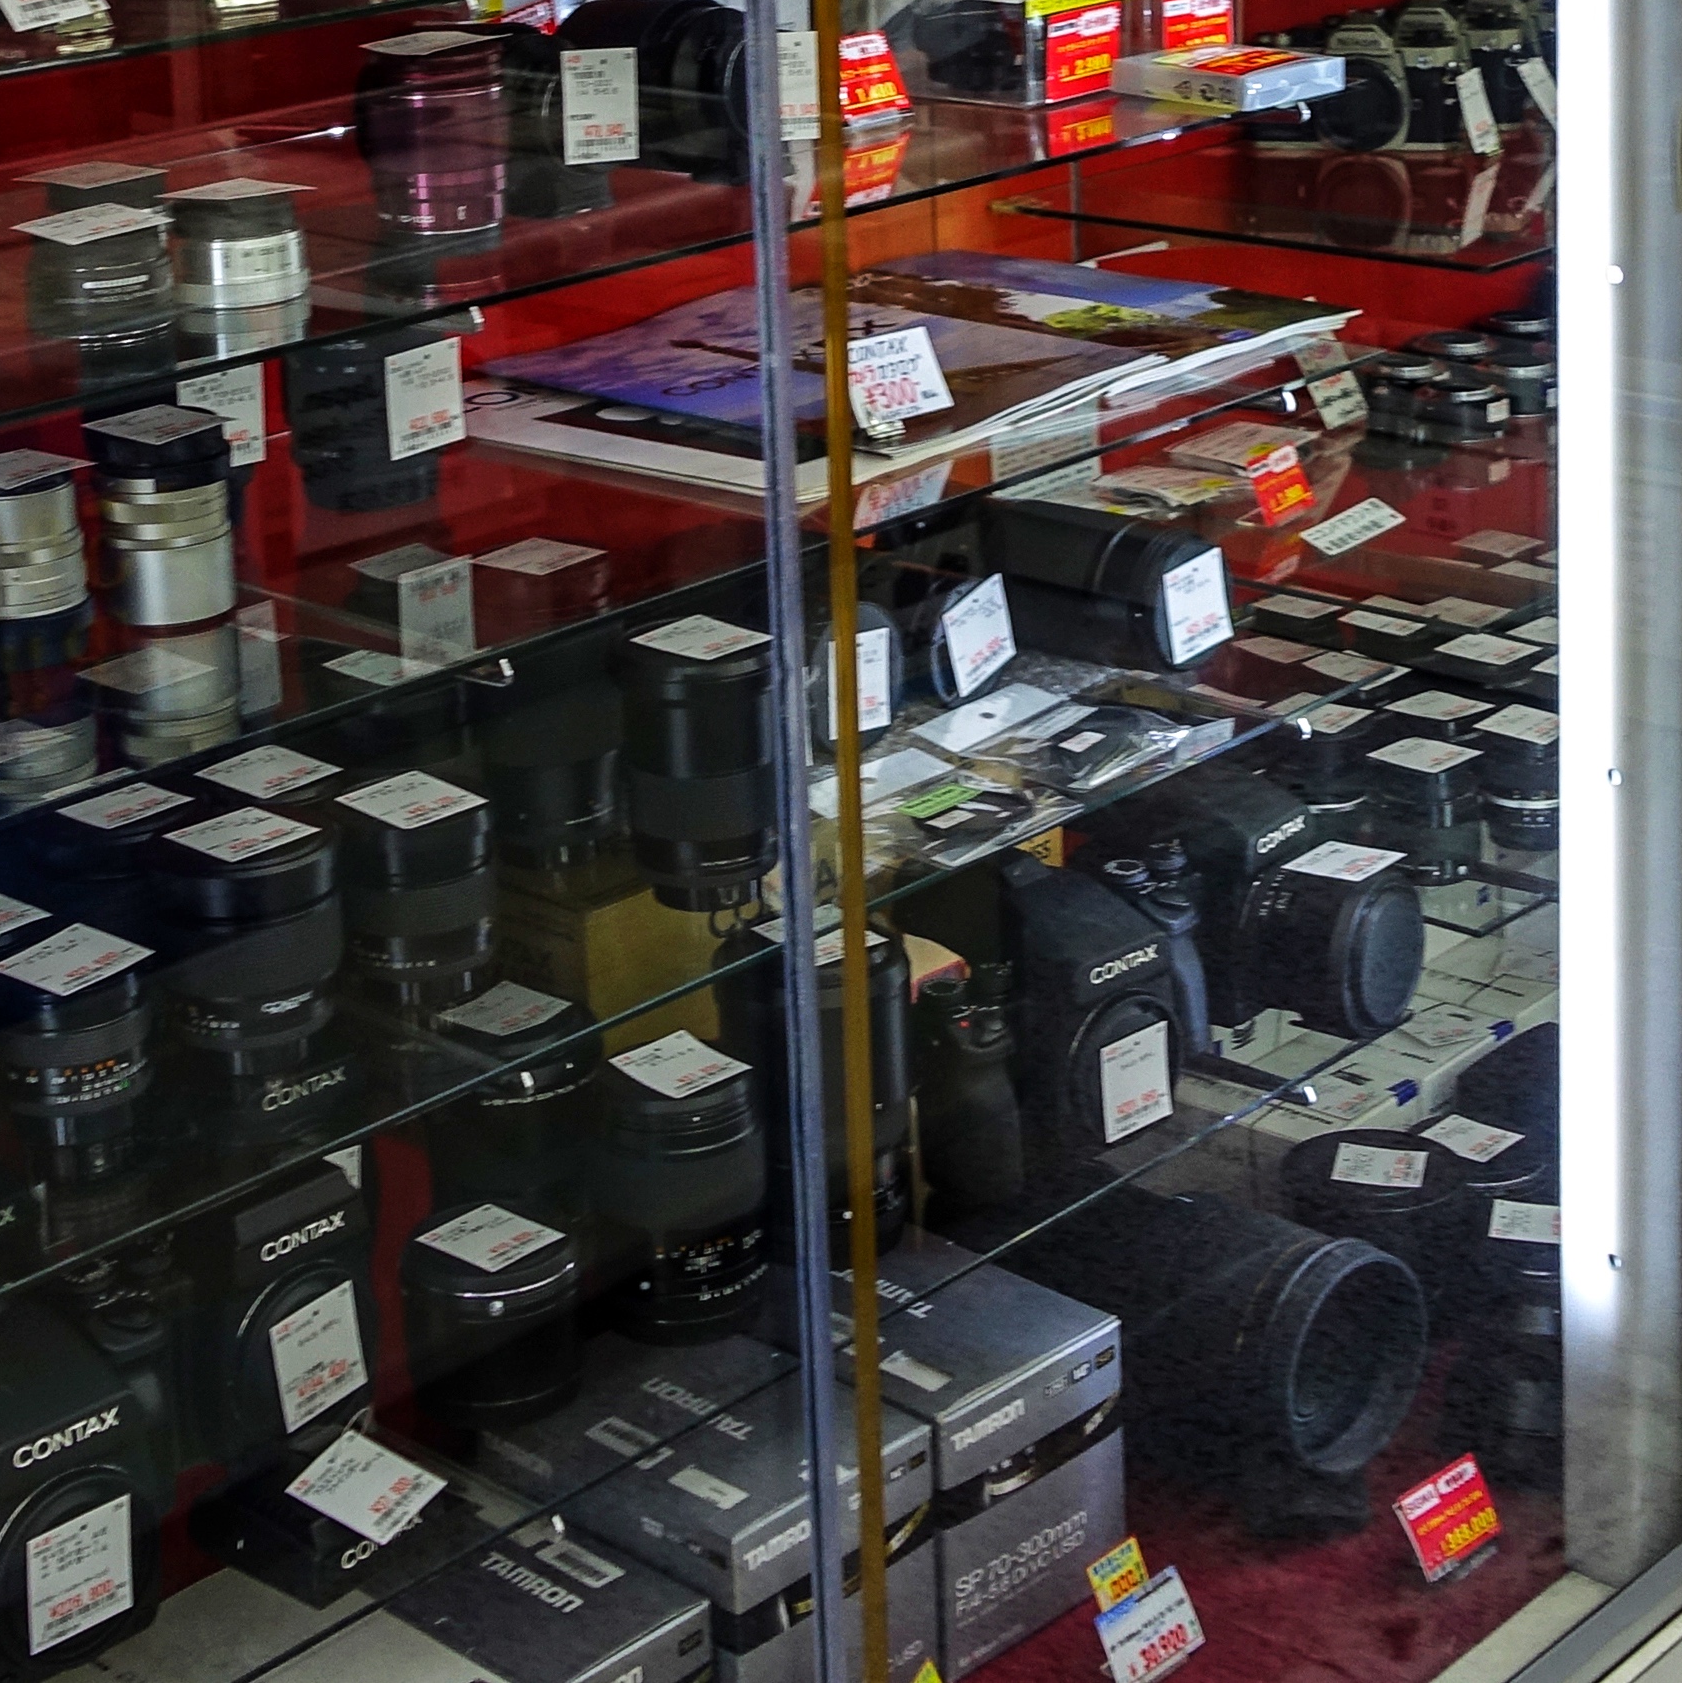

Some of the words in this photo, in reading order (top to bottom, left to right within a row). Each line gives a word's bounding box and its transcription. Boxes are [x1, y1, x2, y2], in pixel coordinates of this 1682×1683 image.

[1254, 813, 1308, 855] CONTAX
[1089, 943, 1159, 987] CONTAX
[262, 1066, 347, 1112] CONTAX
[260, 1211, 347, 1264] CONTAX
[12, 1406, 120, 1470] CONTAX
[950, 1398, 1027, 1452] TAMRON
[743, 1518, 813, 1571] TAMRO
[954, 1570, 994, 1599] SP
[996, 1510, 1089, 1579] 70-300mm
[480, 1551, 585, 1614] TAMRON
